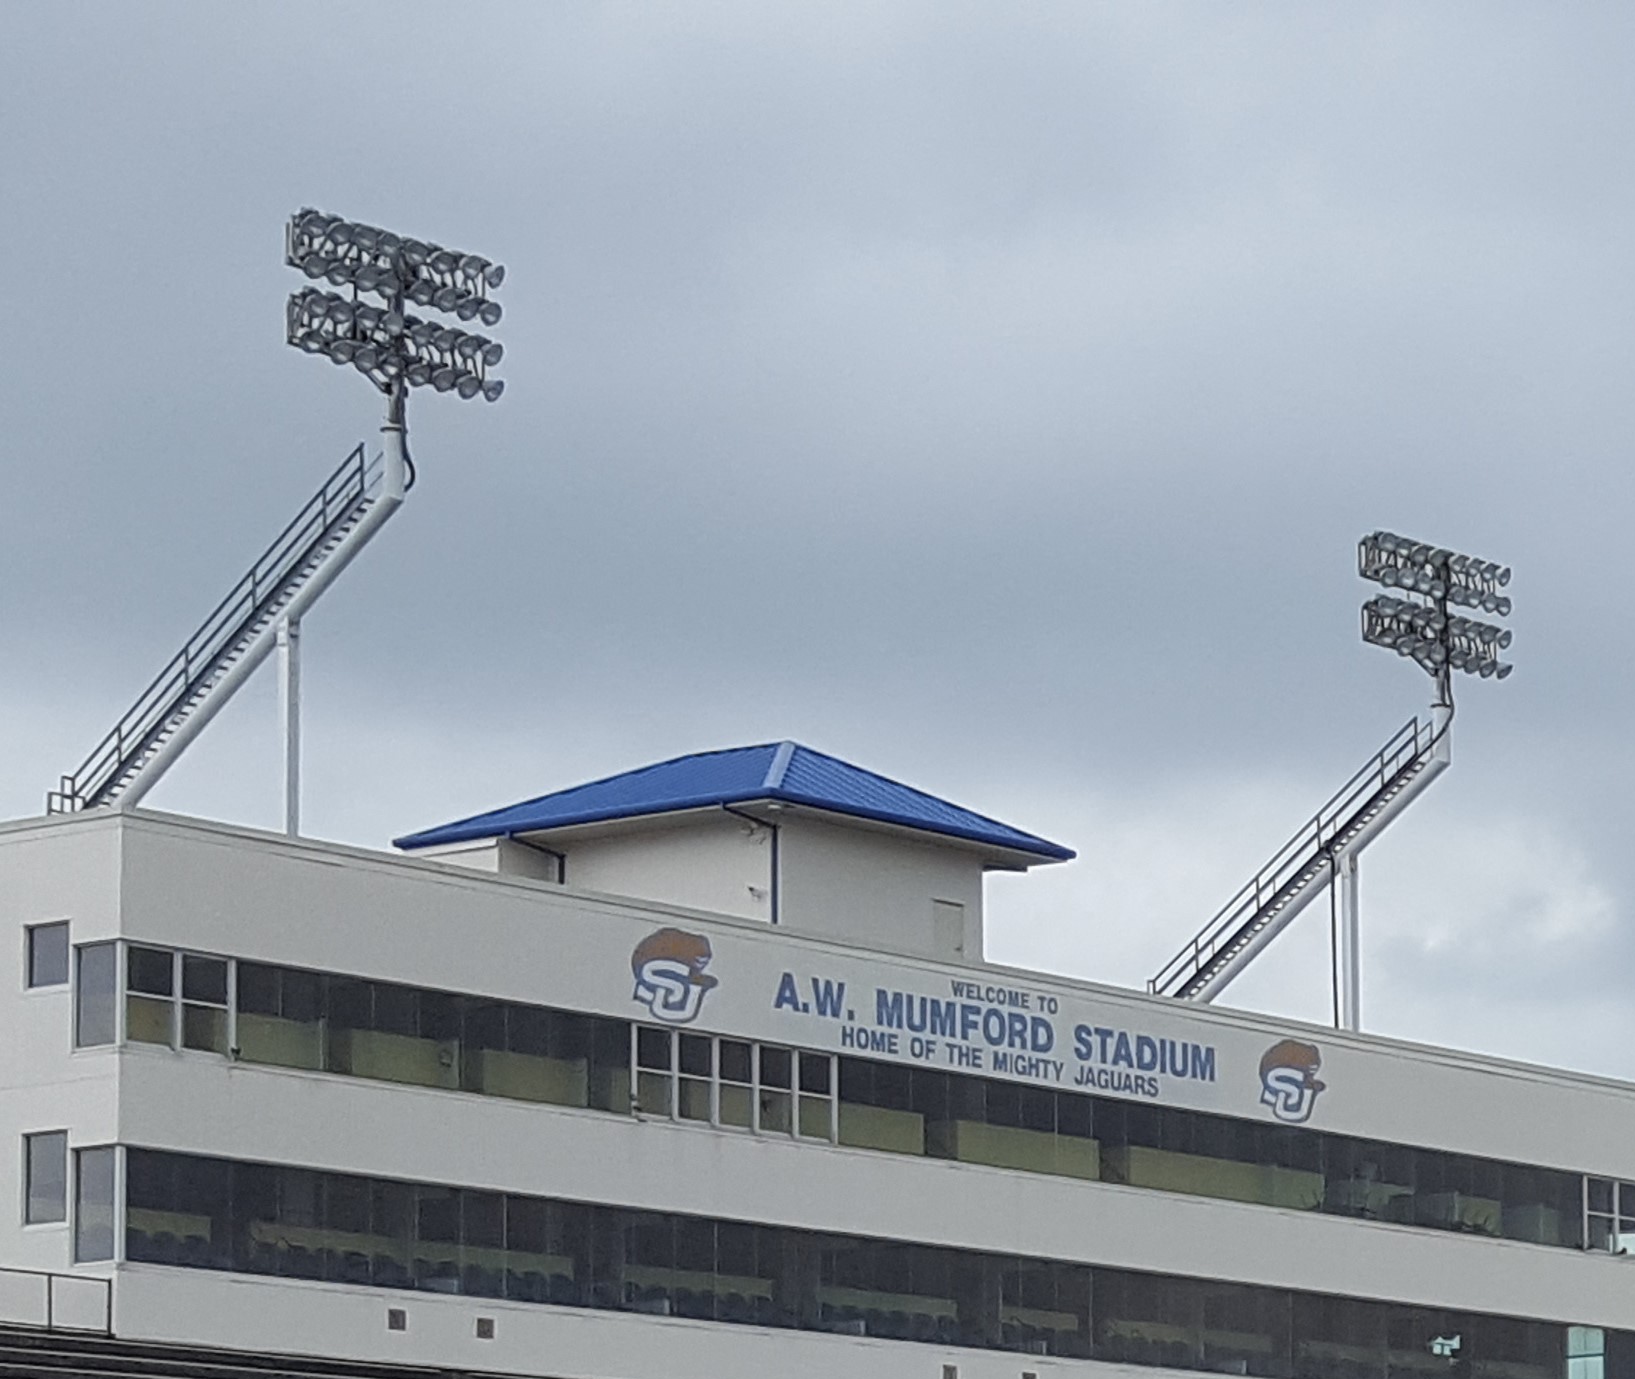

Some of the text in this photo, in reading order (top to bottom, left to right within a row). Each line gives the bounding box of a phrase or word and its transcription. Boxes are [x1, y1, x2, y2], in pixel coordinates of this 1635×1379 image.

[774, 971, 1216, 1082] A.W. MUMFORD STADIUM
[951, 979, 1059, 1015] WELCOME TO
[841, 1025, 1159, 1098] HOME OF THE MIGHTY JAGUARS
